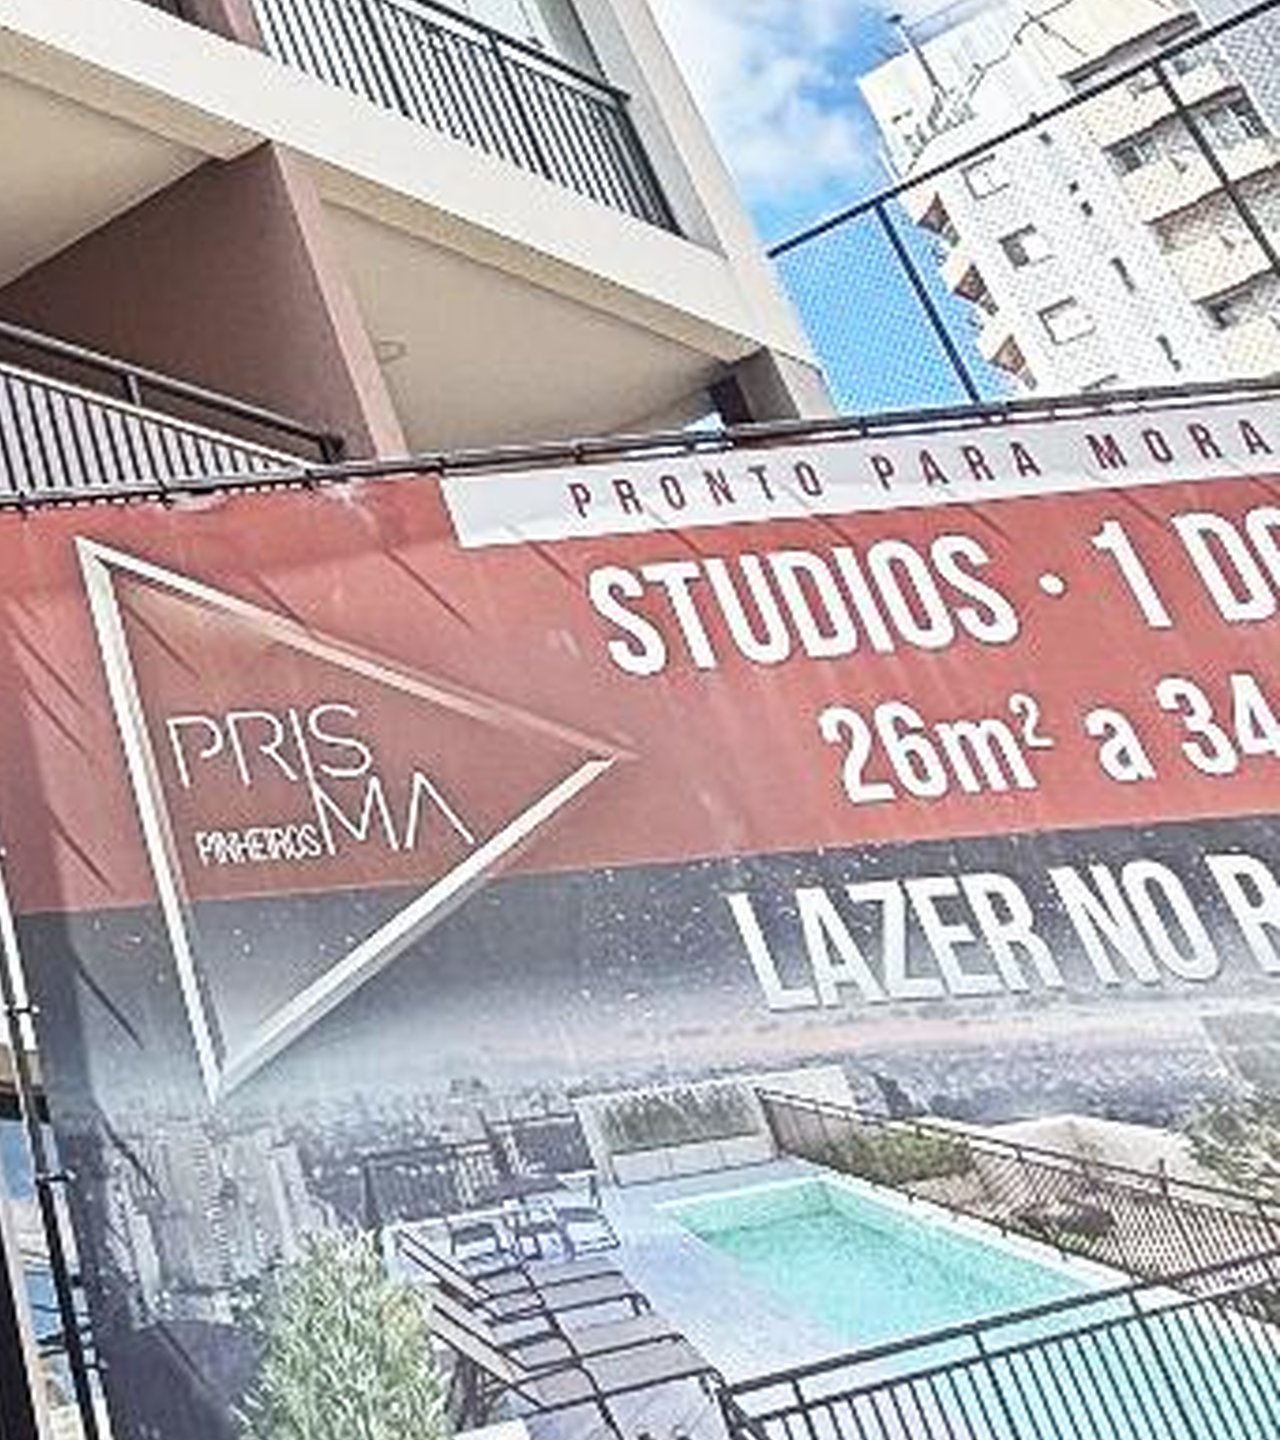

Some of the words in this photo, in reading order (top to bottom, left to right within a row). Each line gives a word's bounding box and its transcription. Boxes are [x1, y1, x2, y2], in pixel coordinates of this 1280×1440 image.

[568, 459, 823, 518] PRONTO
[871, 440, 1041, 491] PARA
[1085, 418, 1274, 470] MORA
[587, 532, 1021, 677] STUDIOS
[1091, 517, 1172, 628] 1
[166, 704, 372, 789] PRIS
[1088, 707, 1157, 782] a
[310, 771, 475, 856] MA
[727, 872, 1065, 1013] LAZER
[1047, 859, 1222, 988] NO
